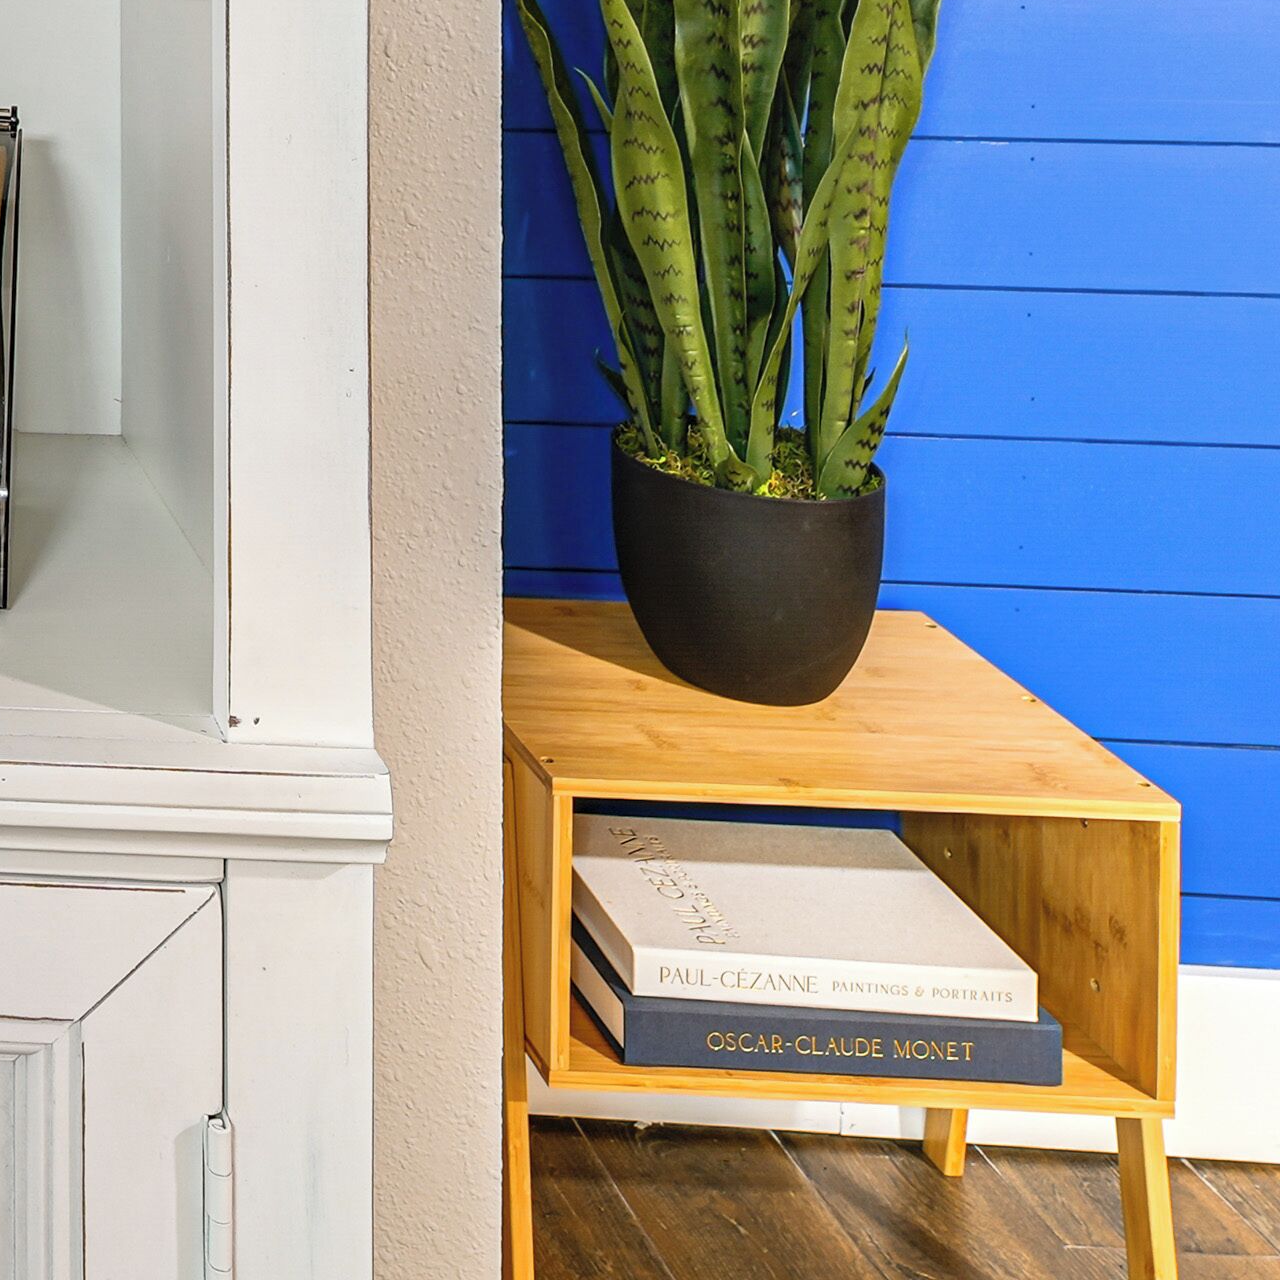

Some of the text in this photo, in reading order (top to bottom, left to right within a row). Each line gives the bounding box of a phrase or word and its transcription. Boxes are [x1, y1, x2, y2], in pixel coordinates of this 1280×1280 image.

[672, 904, 726, 945] PAUL
[659, 966, 1013, 1003] PAUL-CÉZANNE PAINTINGS & PORTRAITS
[706, 1031, 975, 1061] OSCAR-CLAUDE MONET
